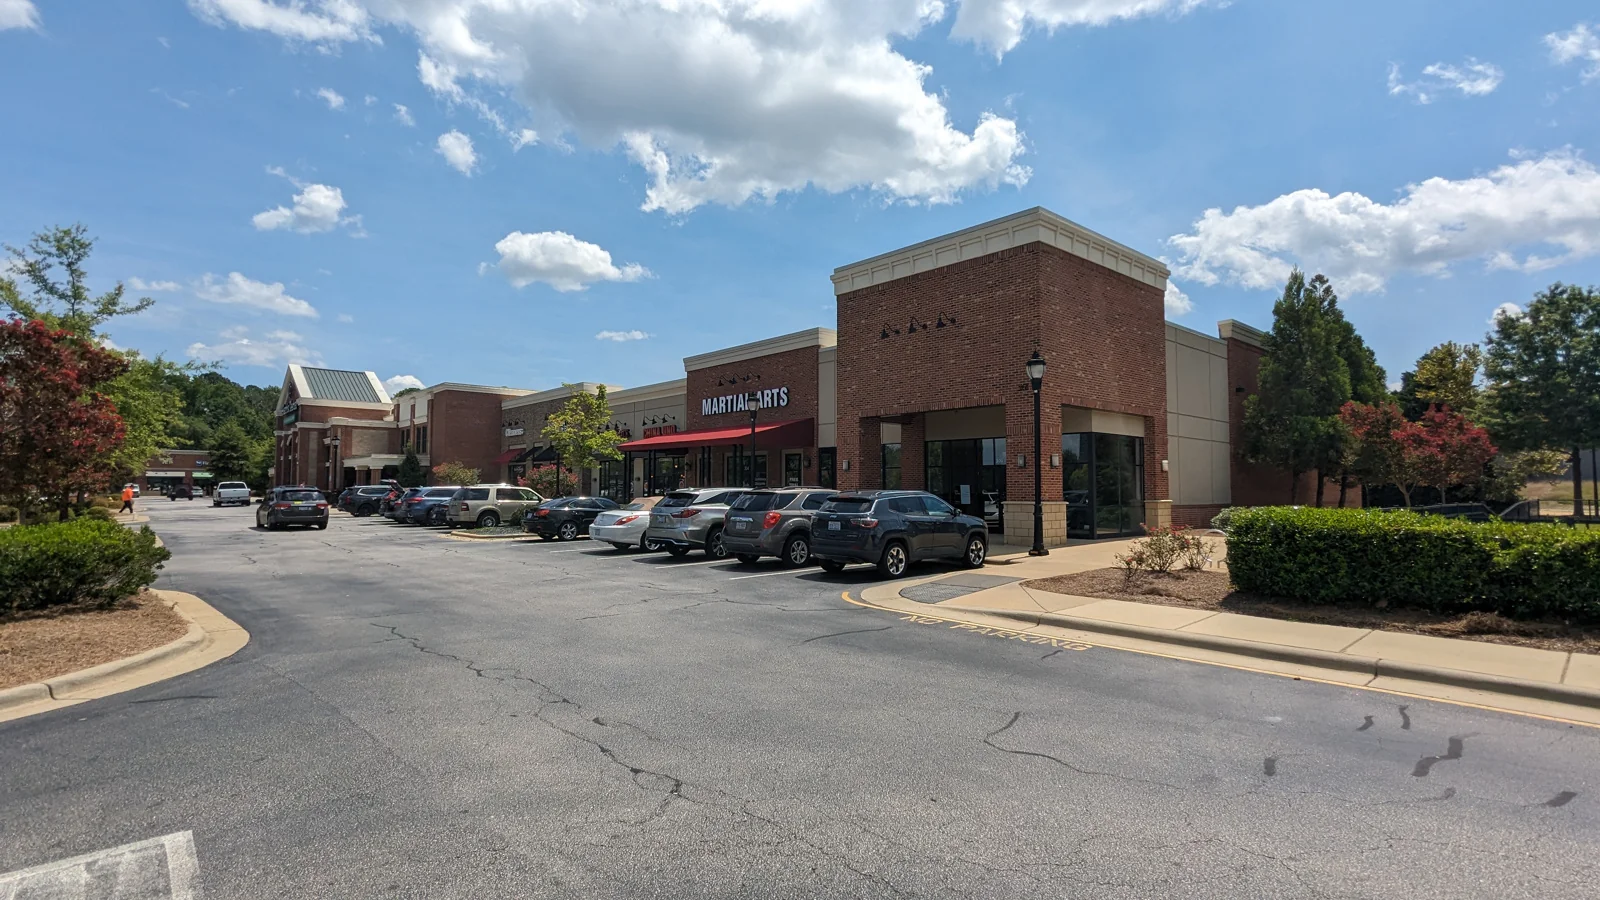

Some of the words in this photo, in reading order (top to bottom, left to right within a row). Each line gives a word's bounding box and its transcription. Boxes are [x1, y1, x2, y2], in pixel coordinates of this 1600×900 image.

[757, 386, 788, 409] ARTS
[899, 614, 943, 625] NO
[949, 623, 1093, 651] PARKING
